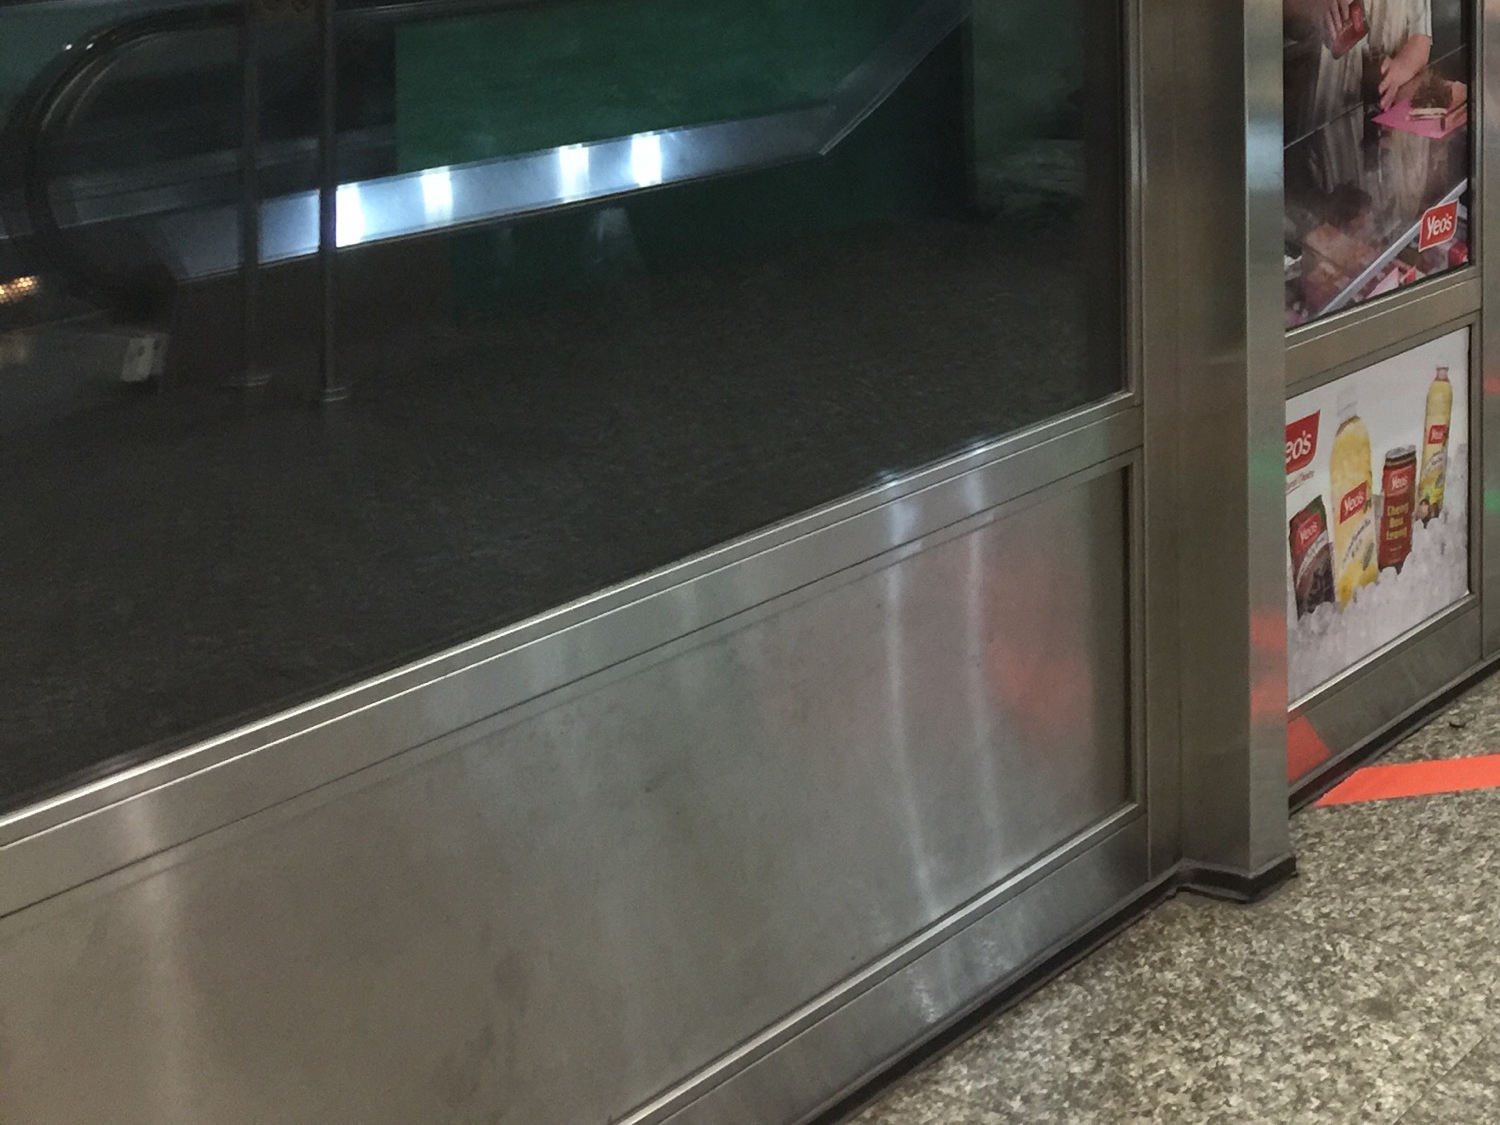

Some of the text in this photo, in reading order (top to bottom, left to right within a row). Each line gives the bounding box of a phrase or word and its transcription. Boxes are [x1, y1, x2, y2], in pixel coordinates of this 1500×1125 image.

[1427, 212, 1453, 240] Yeo's
[1285, 430, 1311, 464] eo's
[1344, 490, 1365, 516] Yeo's
